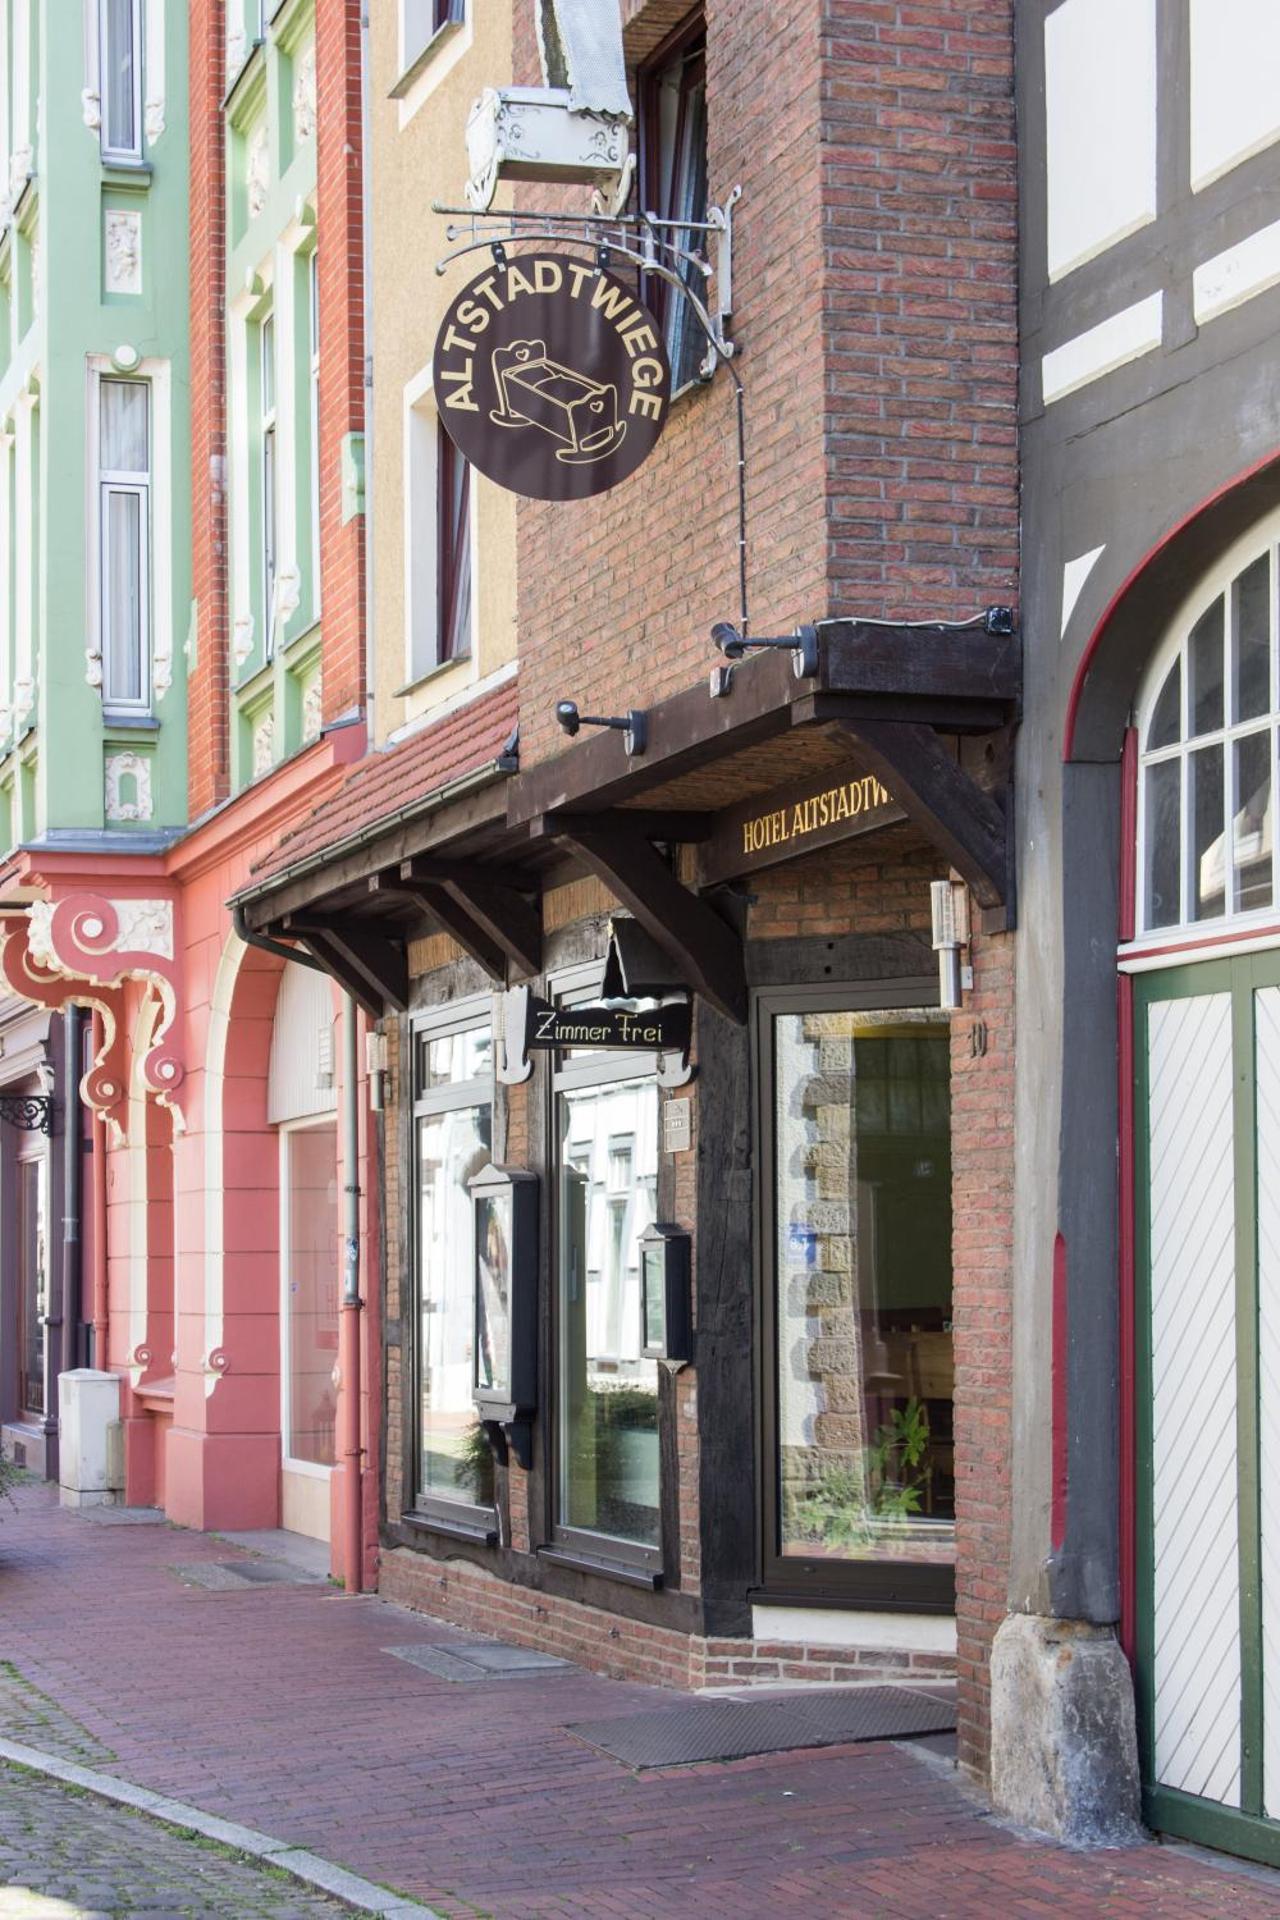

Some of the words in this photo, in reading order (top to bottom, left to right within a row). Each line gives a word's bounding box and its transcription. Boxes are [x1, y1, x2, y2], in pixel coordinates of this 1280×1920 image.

[441, 261, 663, 420] ALTSTADTWIEGE
[743, 809, 790, 854] HOTEL
[791, 775, 894, 837] ALTSTADTW
[535, 1011, 611, 1041] Zimmer
